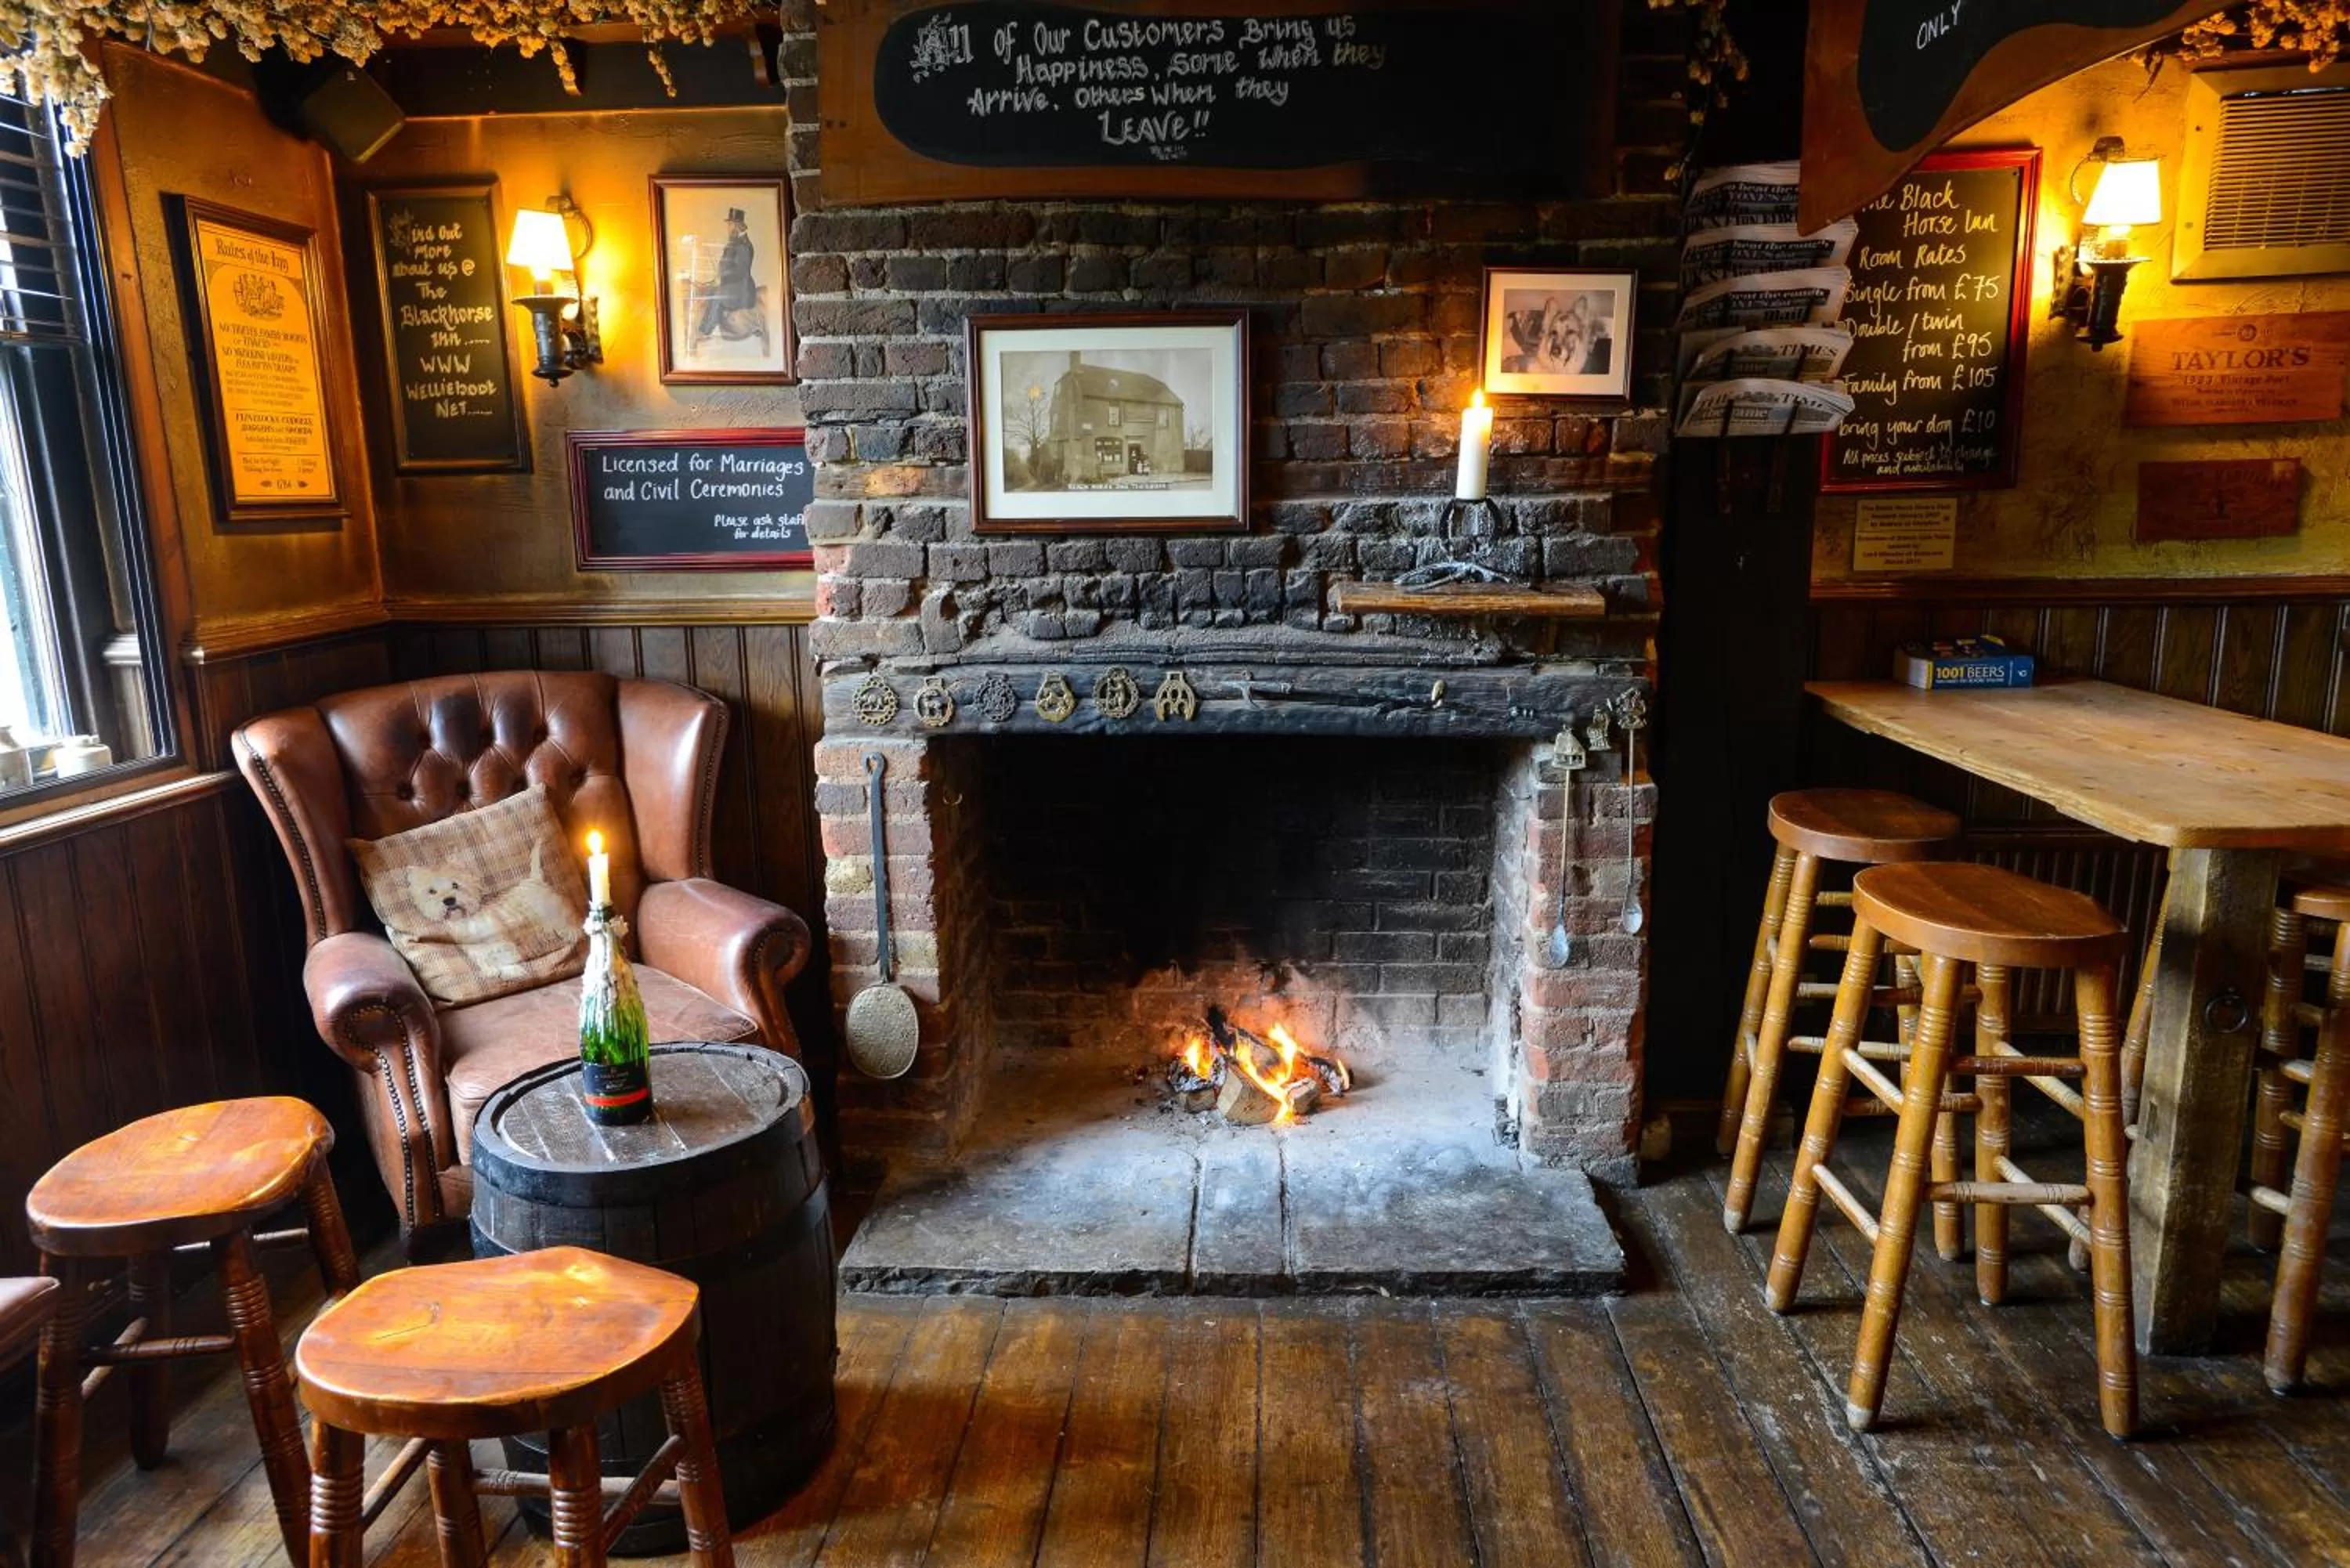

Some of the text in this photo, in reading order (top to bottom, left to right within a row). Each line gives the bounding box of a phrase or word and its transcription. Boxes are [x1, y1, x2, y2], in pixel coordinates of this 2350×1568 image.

[1916, 0, 1961, 50] ONLY
[993, 20, 1018, 65] of
[1034, 20, 1071, 56] Our
[1083, 18, 1225, 51] Customers
[1238, 17, 1316, 50] Bring
[1325, 15, 1357, 39] us
[1332, 40, 1386, 70] they
[1234, 75, 1289, 107] they
[1900, 179, 1959, 211] Black
[1903, 209, 1999, 238] Horse Inn
[215, 237, 289, 274] Rules of the Inn
[438, 261, 458, 281] us
[461, 258, 475, 276] @
[1859, 245, 1904, 270] Room
[1914, 243, 1967, 269] Rates
[415, 281, 448, 300] The
[1844, 275, 1903, 319] Single
[1906, 276, 1946, 302] from
[1954, 273, 2001, 302] £75
[1902, 331, 1993, 363] from £95
[2171, 346, 2312, 370] TAYLOR'S
[1842, 363, 1998, 406] Family from £105
[1838, 407, 1996, 452] bring your dog £10
[602, 453, 804, 482] Licensed for Marriages
[603, 478, 784, 501] and Civil Ceremonies
[734, 526, 792, 540] for details
[753, 513, 774, 527] ask
[1935, 665, 2005, 679] 1001 BEERS
